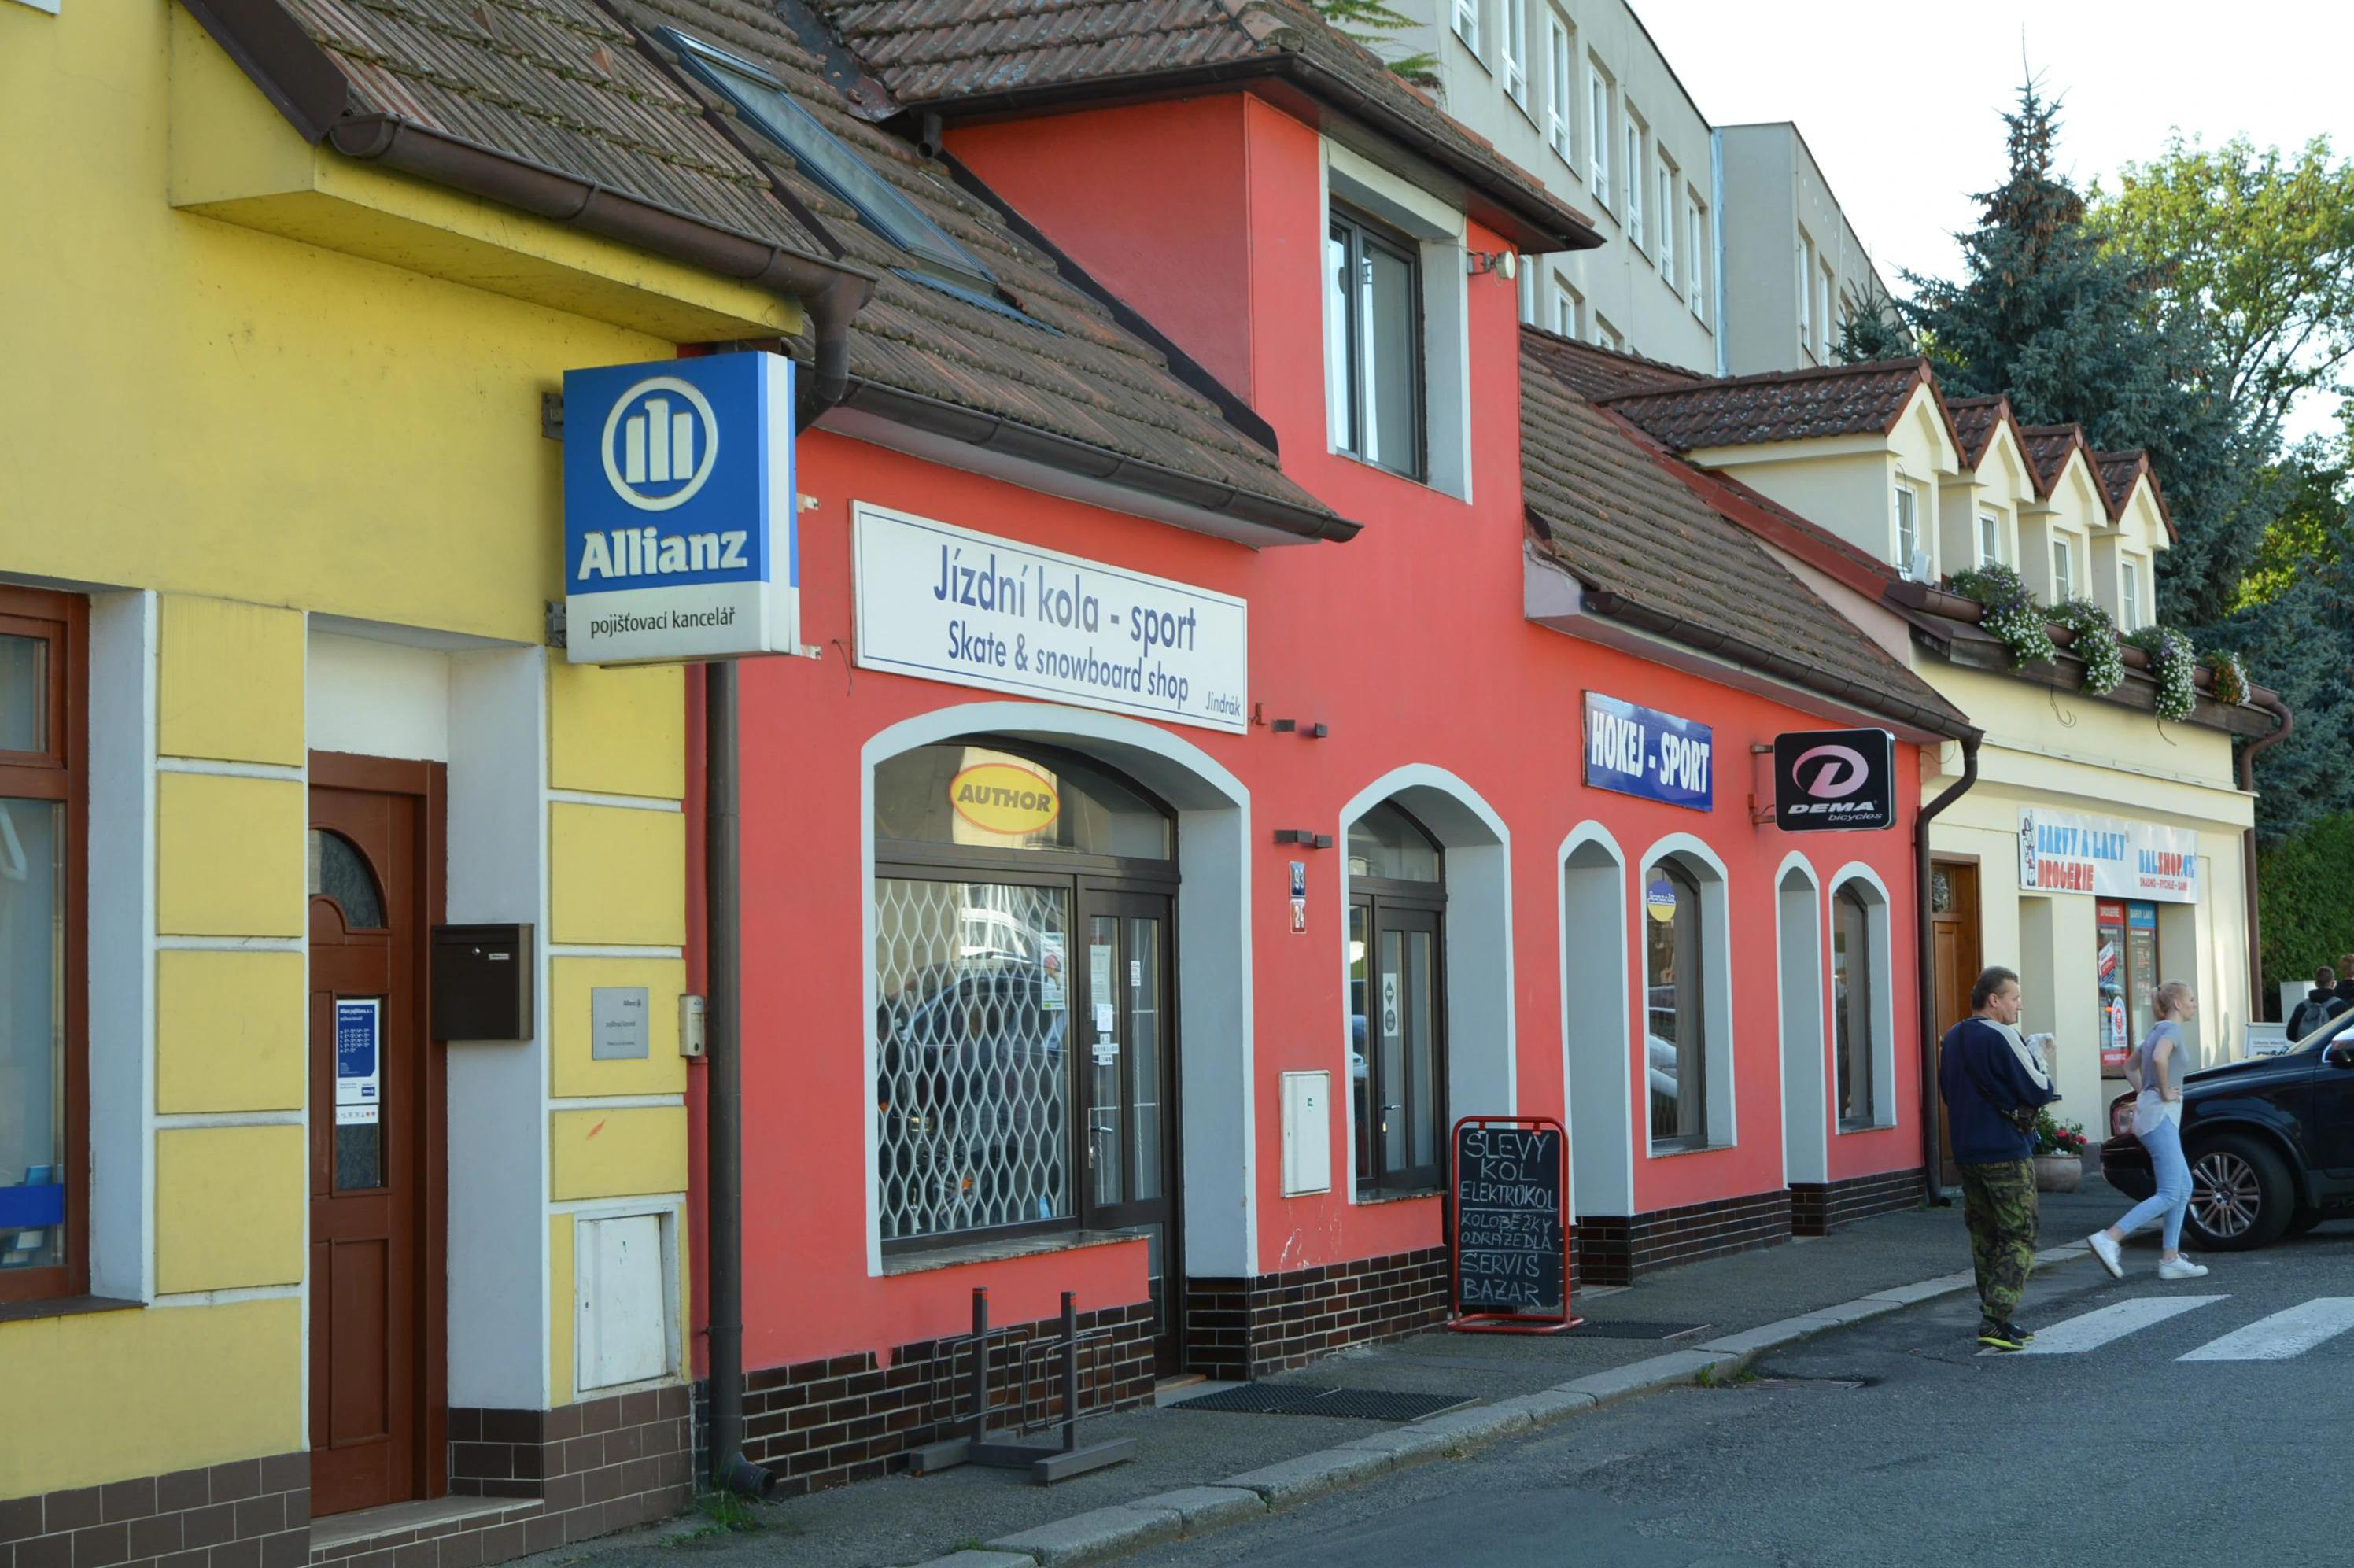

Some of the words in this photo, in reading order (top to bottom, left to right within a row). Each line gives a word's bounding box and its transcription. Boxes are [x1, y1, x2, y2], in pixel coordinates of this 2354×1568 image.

[577, 526, 748, 581] Allianz
[933, 544, 1029, 618] Jízdní
[1038, 566, 1099, 633] kola
[1130, 605, 1197, 657] sport
[590, 611, 668, 639] pojišťovací
[672, 607, 736, 629] kancelář
[948, 620, 1007, 667] Skate
[1014, 633, 1028, 672] &
[1035, 647, 1142, 692] snowboard
[1147, 661, 1189, 709] shop
[1205, 690, 1241, 717] Jindrák
[1591, 710, 1645, 778] HOKEJ
[1659, 732, 1710, 794] SPORT
[957, 783, 1051, 812] AUTHOR
[1788, 801, 1875, 814] DEMA
[1828, 812, 1883, 821] bicycles
[2038, 824, 2078, 855] BARVY
[2081, 829, 2090, 858] A
[2093, 831, 2126, 861] LAKY
[2038, 859, 2095, 891] DROGERIE
[1464, 1132, 1550, 1163] SLEVY
[1480, 1158, 1538, 1181] KOL
[1459, 1180, 1556, 1210] ELEKTROKOL
[1459, 1253, 1540, 1278] SERVIS
[1461, 1277, 1542, 1308] BAZAR
